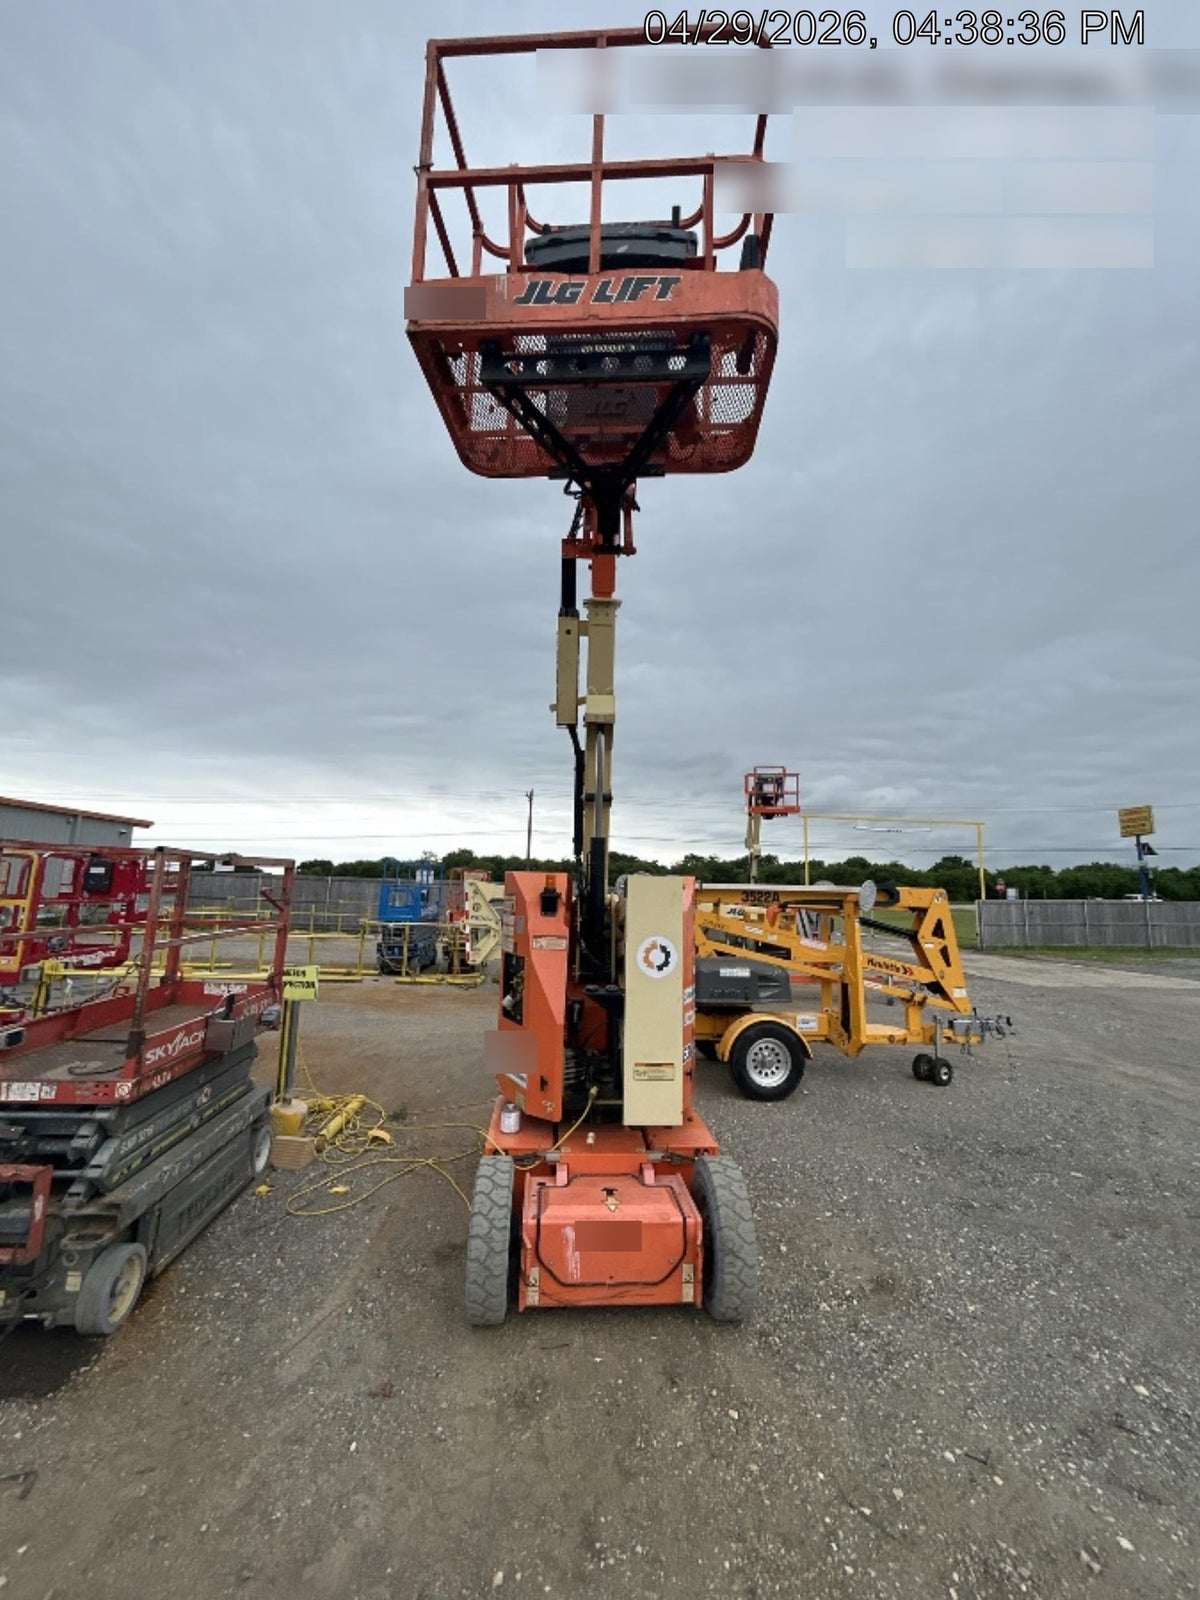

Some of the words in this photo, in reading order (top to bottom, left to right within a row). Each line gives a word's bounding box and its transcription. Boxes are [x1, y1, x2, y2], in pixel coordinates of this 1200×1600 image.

[513, 280, 589, 306] JLG
[590, 275, 683, 304] LIFT
[741, 890, 780, 903] 3522A
